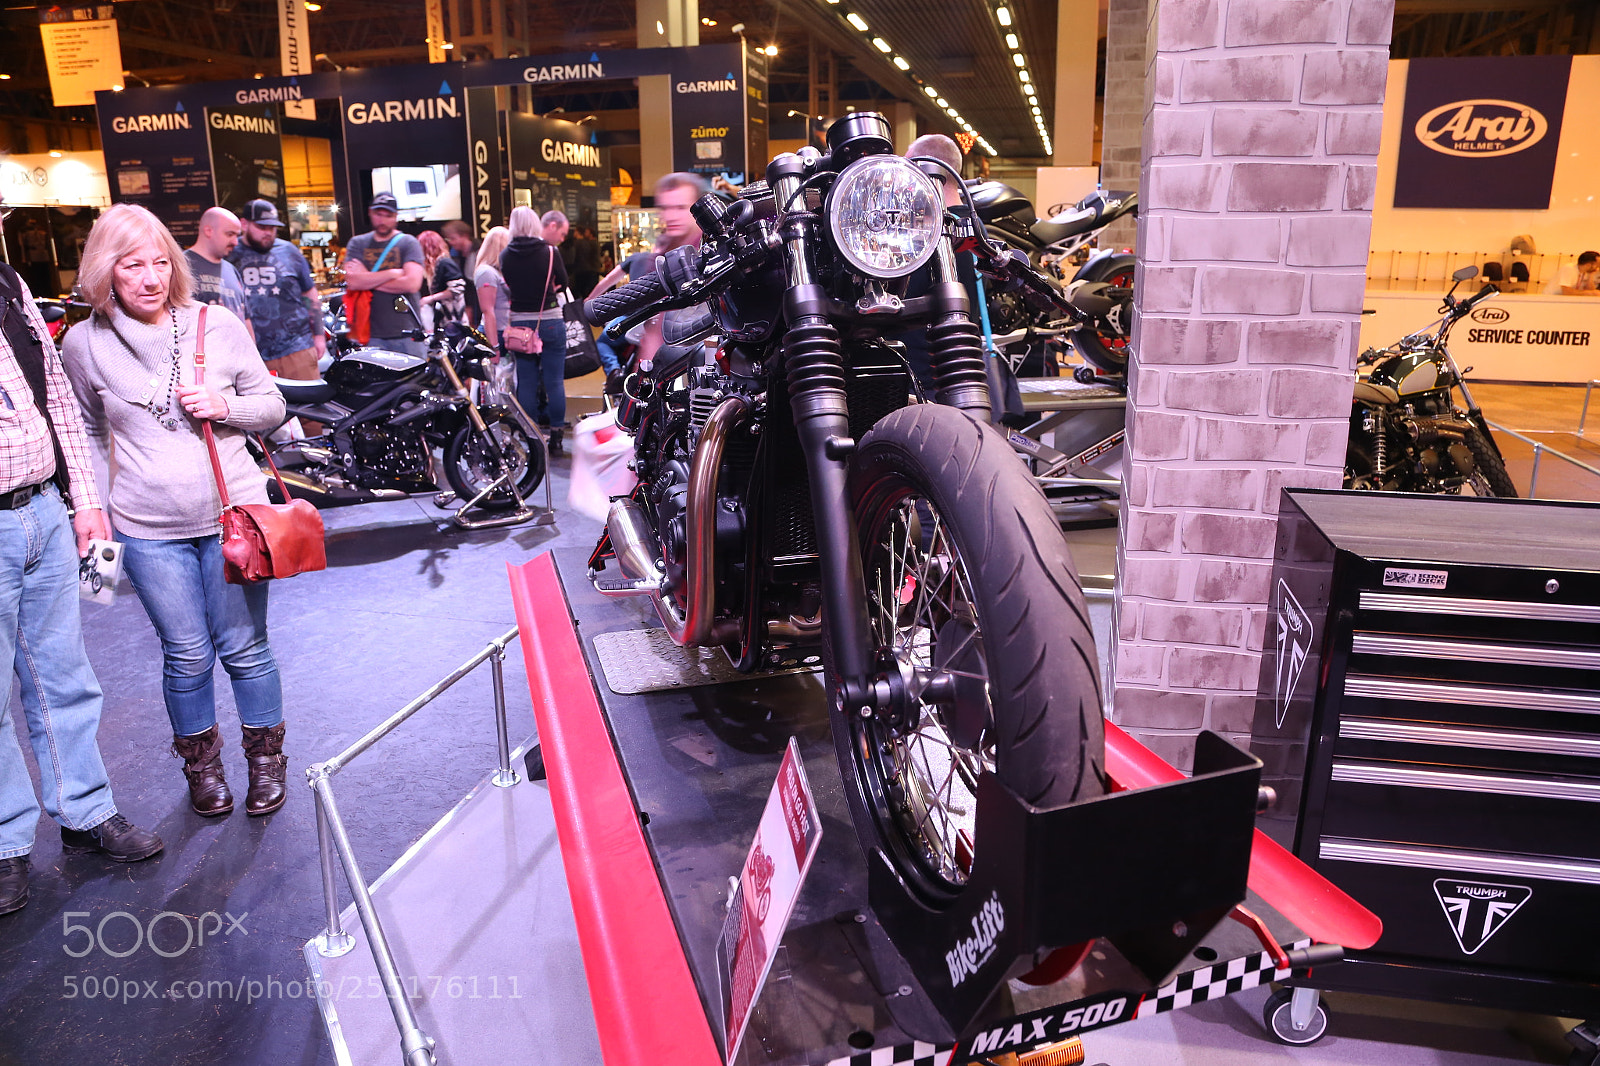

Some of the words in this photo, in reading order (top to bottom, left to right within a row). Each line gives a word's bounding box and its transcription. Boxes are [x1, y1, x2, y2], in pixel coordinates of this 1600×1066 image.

[523, 63, 603, 82] GARMIN
[235, 86, 302, 105] GARMIN
[676, 79, 737, 94] GARMIN
[347, 96, 458, 125] GARMIN
[112, 112, 190, 134] GARMIN
[210, 112, 277, 135] GARMIN
[1422, 104, 1532, 141] Arai
[541, 138, 600, 168] GARMIN
[1454, 142, 1502, 150] HELMET
[243, 266, 277, 287] 85
[1474, 308, 1507, 321] Arai
[1468, 328, 1524, 345] SERVICE
[1526, 329, 1591, 347] COUNTER
[1455, 885, 1507, 900] TRIUMPH
[969, 1014, 1055, 1057] MAX
[1058, 997, 1128, 1034] 500
